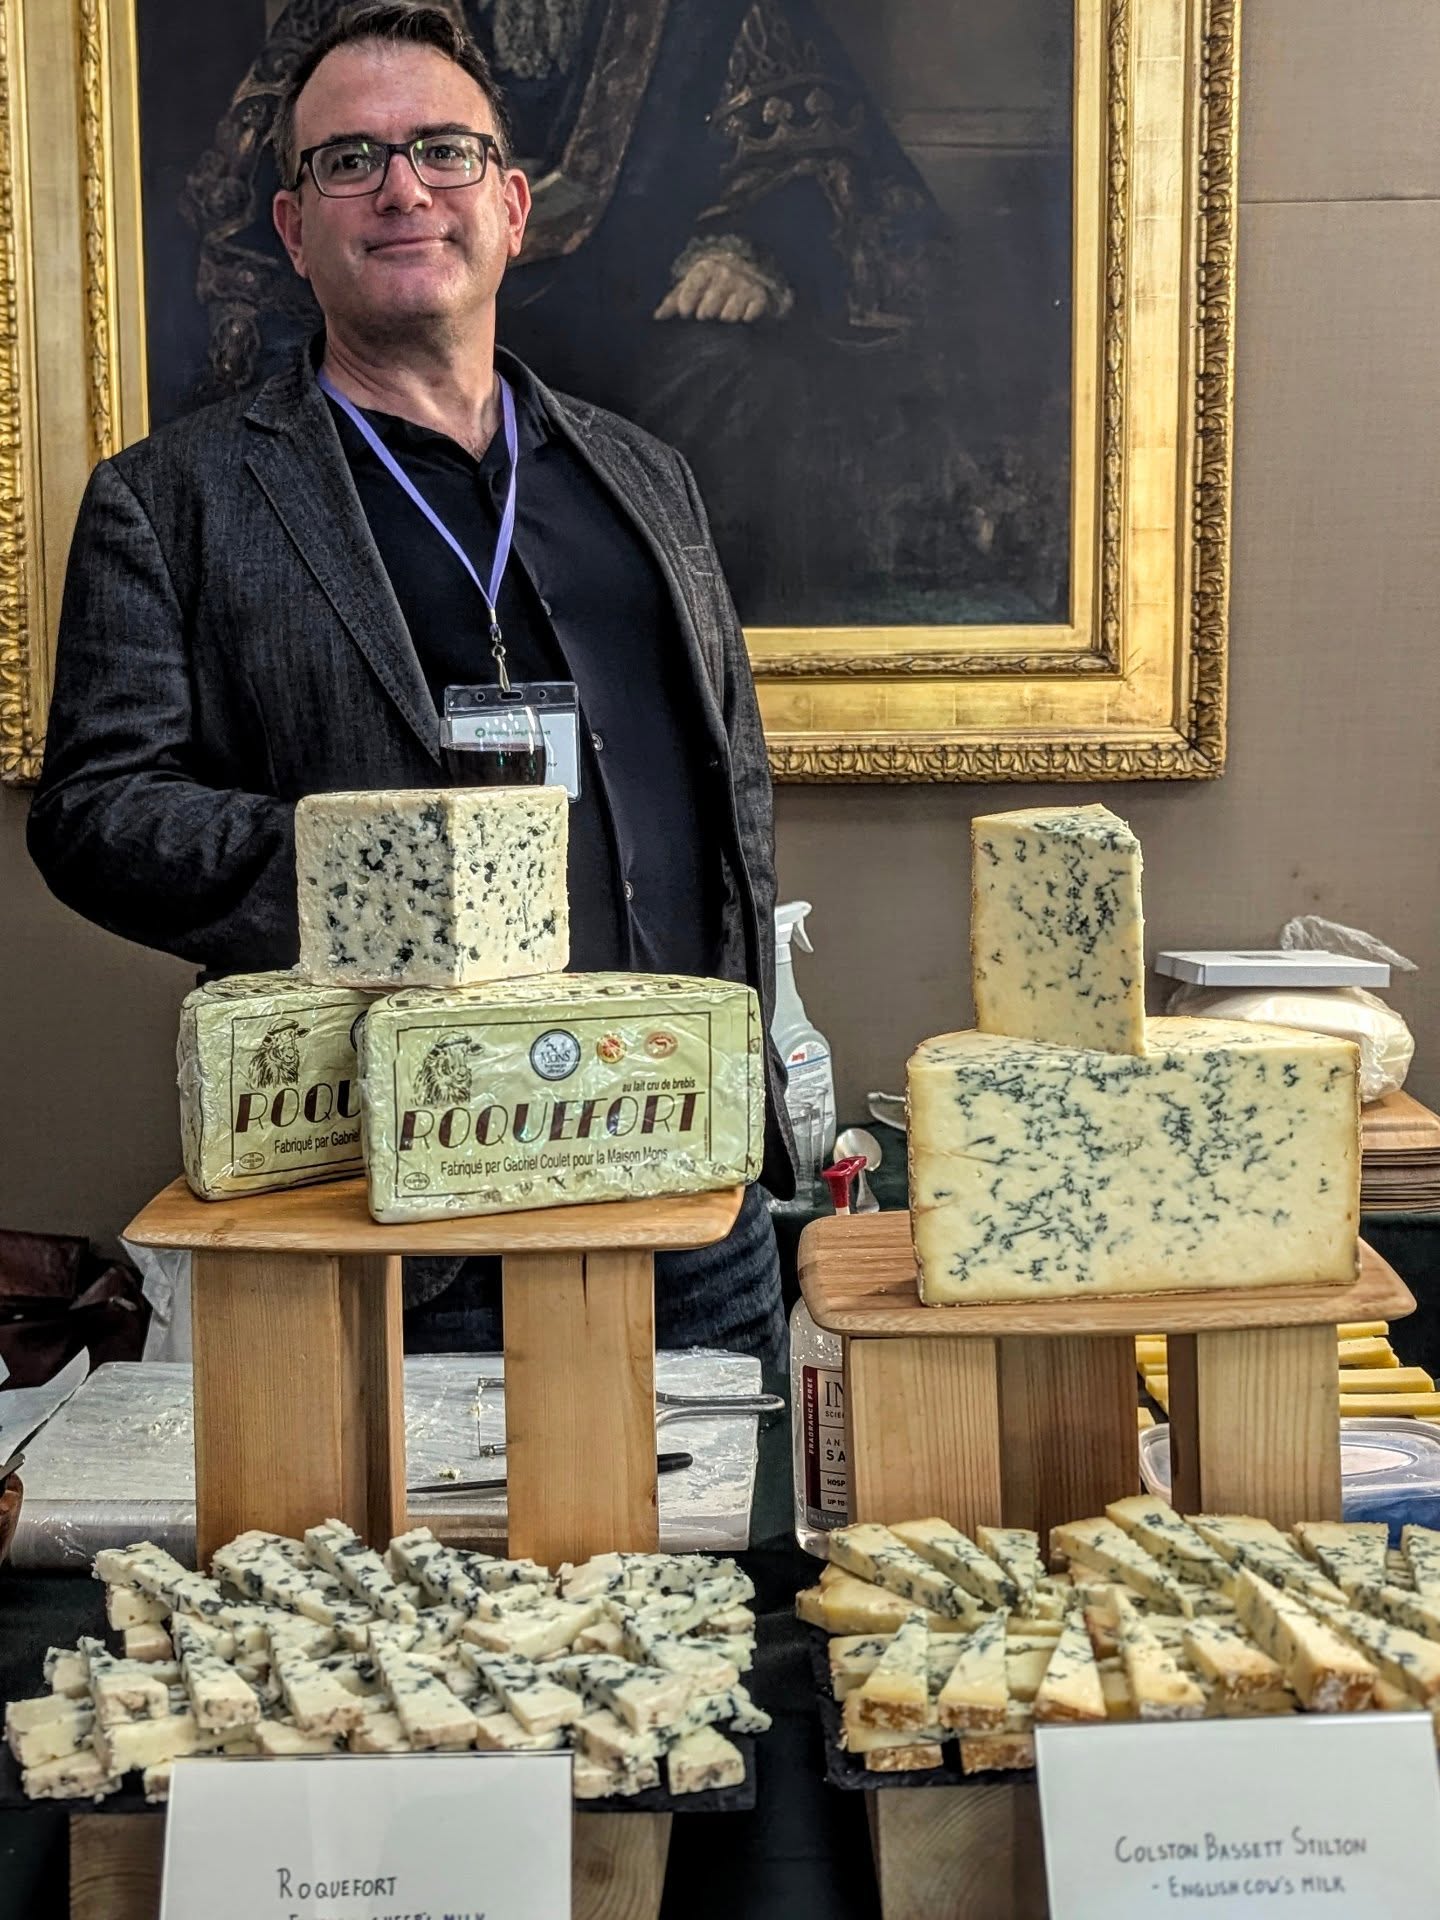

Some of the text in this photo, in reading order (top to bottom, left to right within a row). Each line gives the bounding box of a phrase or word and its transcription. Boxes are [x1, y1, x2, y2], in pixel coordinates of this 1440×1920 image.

[622, 1077, 696, 1092] au lait cru de brebis
[399, 1092, 706, 1151] ROQUEFORT
[274, 1136, 313, 1155] Fabriqué
[314, 1136, 330, 1152] par
[441, 1146, 668, 1177] Fabriqué par Gabriel Coulet pour la Maison Mons
[825, 1410, 845, 1419] SCIE
[826, 1450, 846, 1462] SA
[827, 1479, 846, 1487] HOSP
[1115, 1826, 1367, 1862] COLSTON BASSETT STILTON
[276, 1867, 398, 1899] ROQUEFORT
[1168, 1876, 1239, 1897] ENGLISH
[1243, 1876, 1295, 1895] COW'S
[1301, 1876, 1345, 1894] MILK
